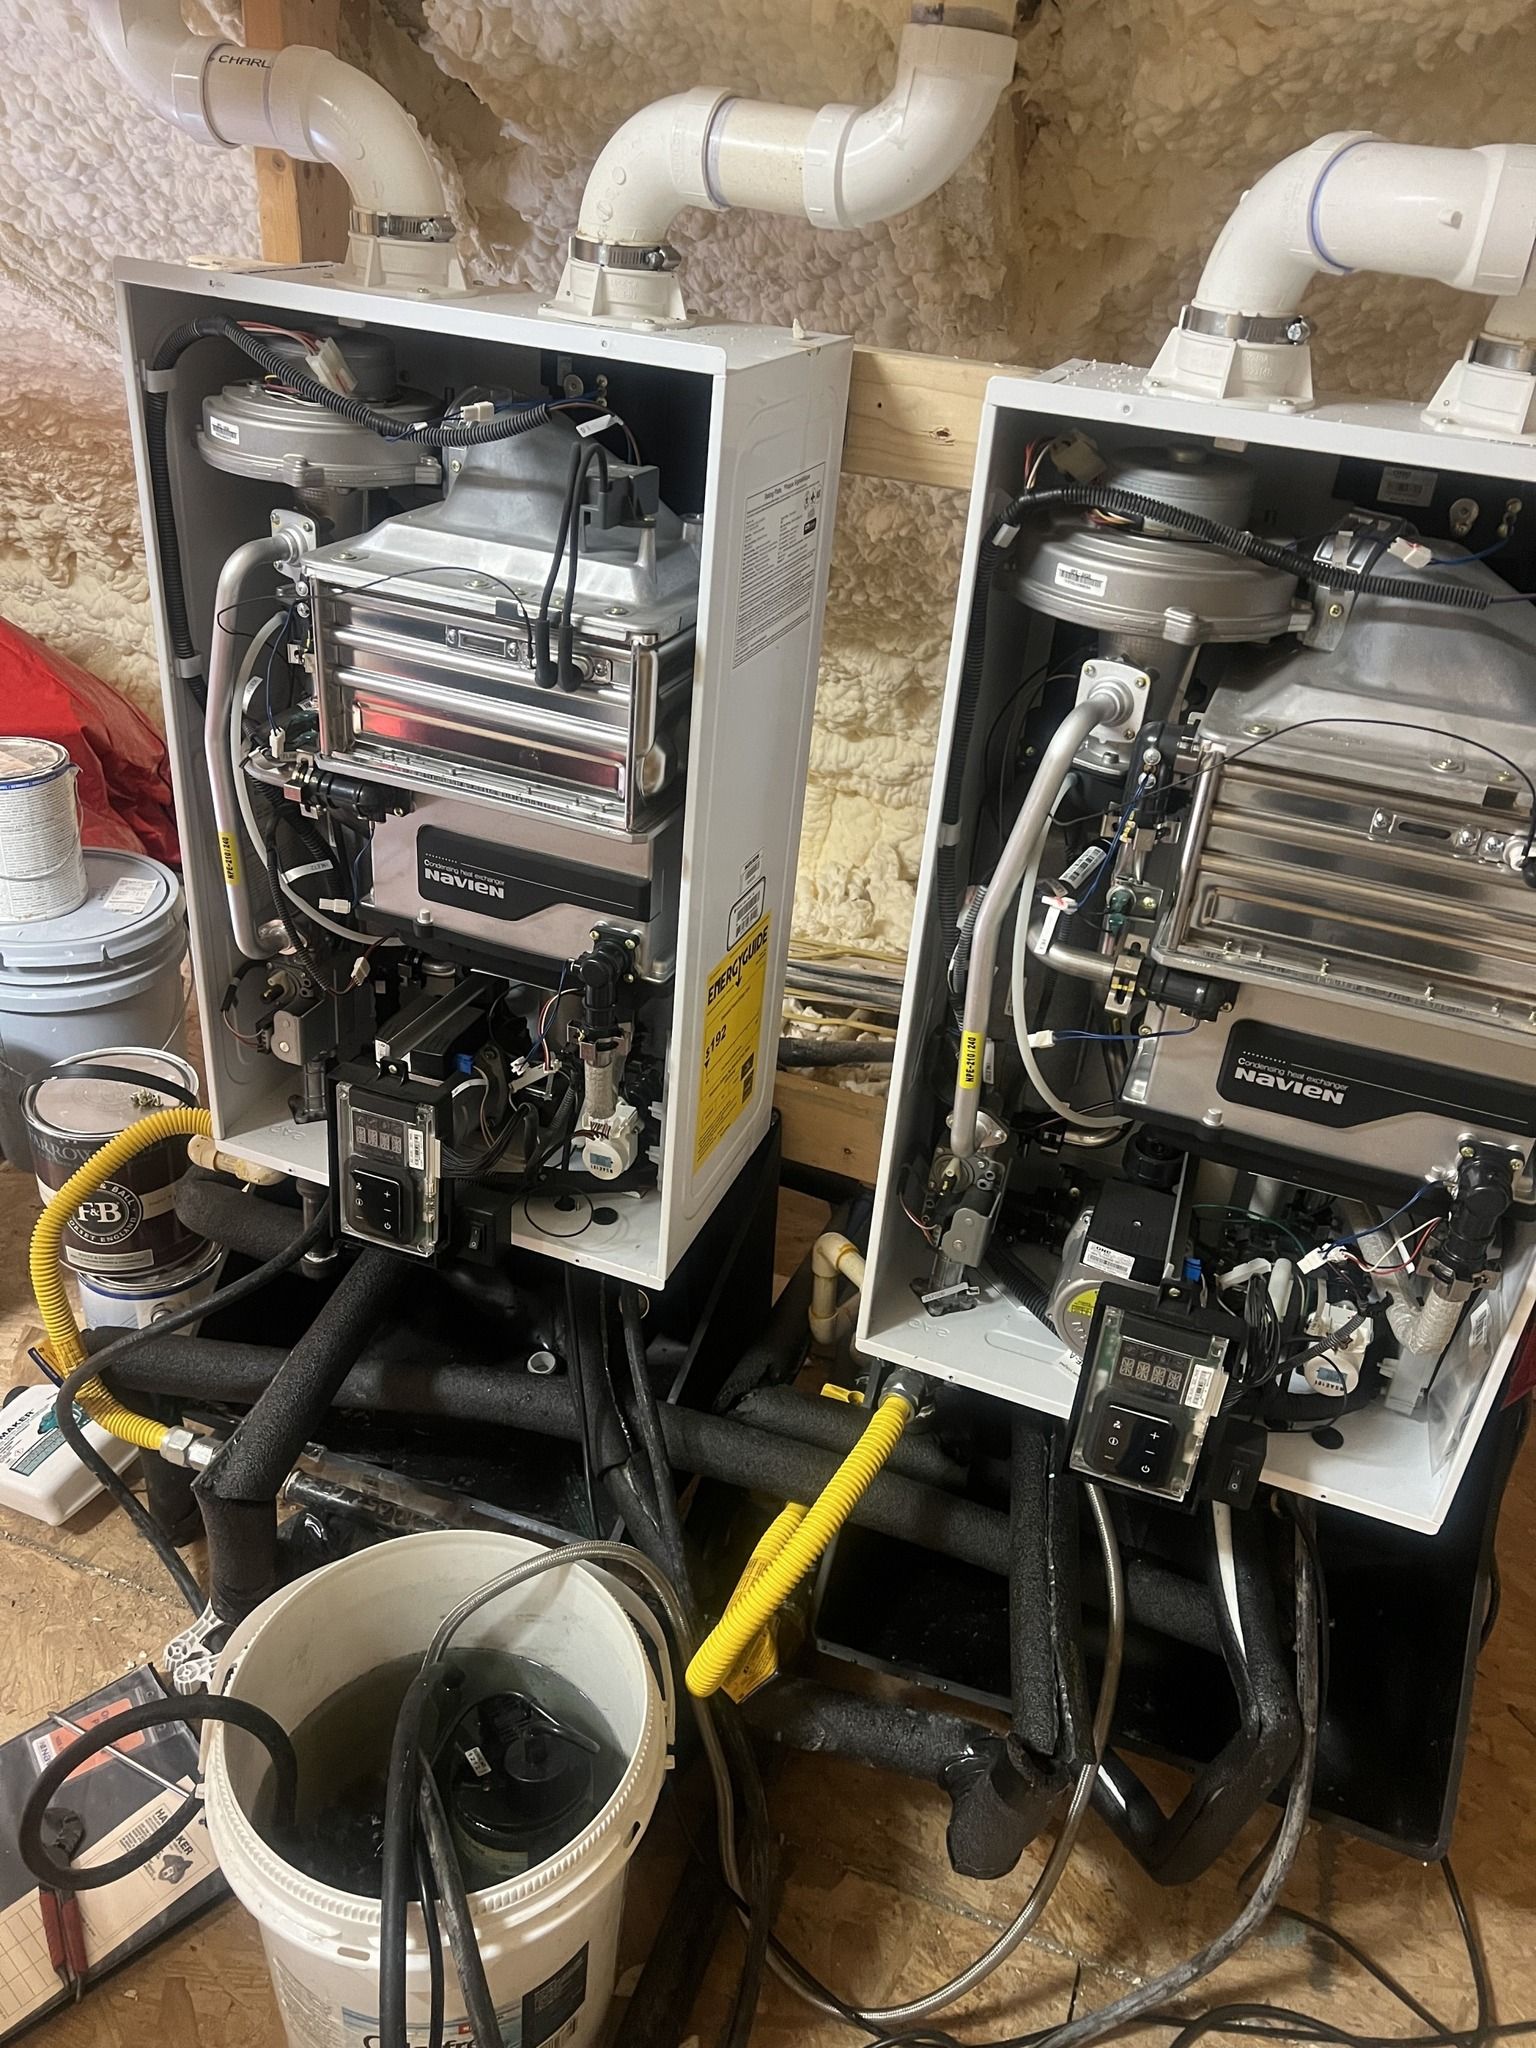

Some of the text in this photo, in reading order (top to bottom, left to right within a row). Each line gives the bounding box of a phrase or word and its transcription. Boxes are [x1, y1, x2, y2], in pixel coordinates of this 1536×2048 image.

[218, 54, 271, 69] CHARL
[424, 859, 505, 885] Condensing heat exchanger
[707, 924, 769, 1006] ENERGYGUIDE
[705, 1023, 727, 1059] $192
[965, 1036, 976, 1082] NPE-210/240
[1238, 1057, 1350, 1090] Condensing heat exchanger
[111, 1186, 134, 1206] BALL
[77, 1202, 122, 1223] F&B
[68, 1216, 138, 1243] ORSET ENGLAND
